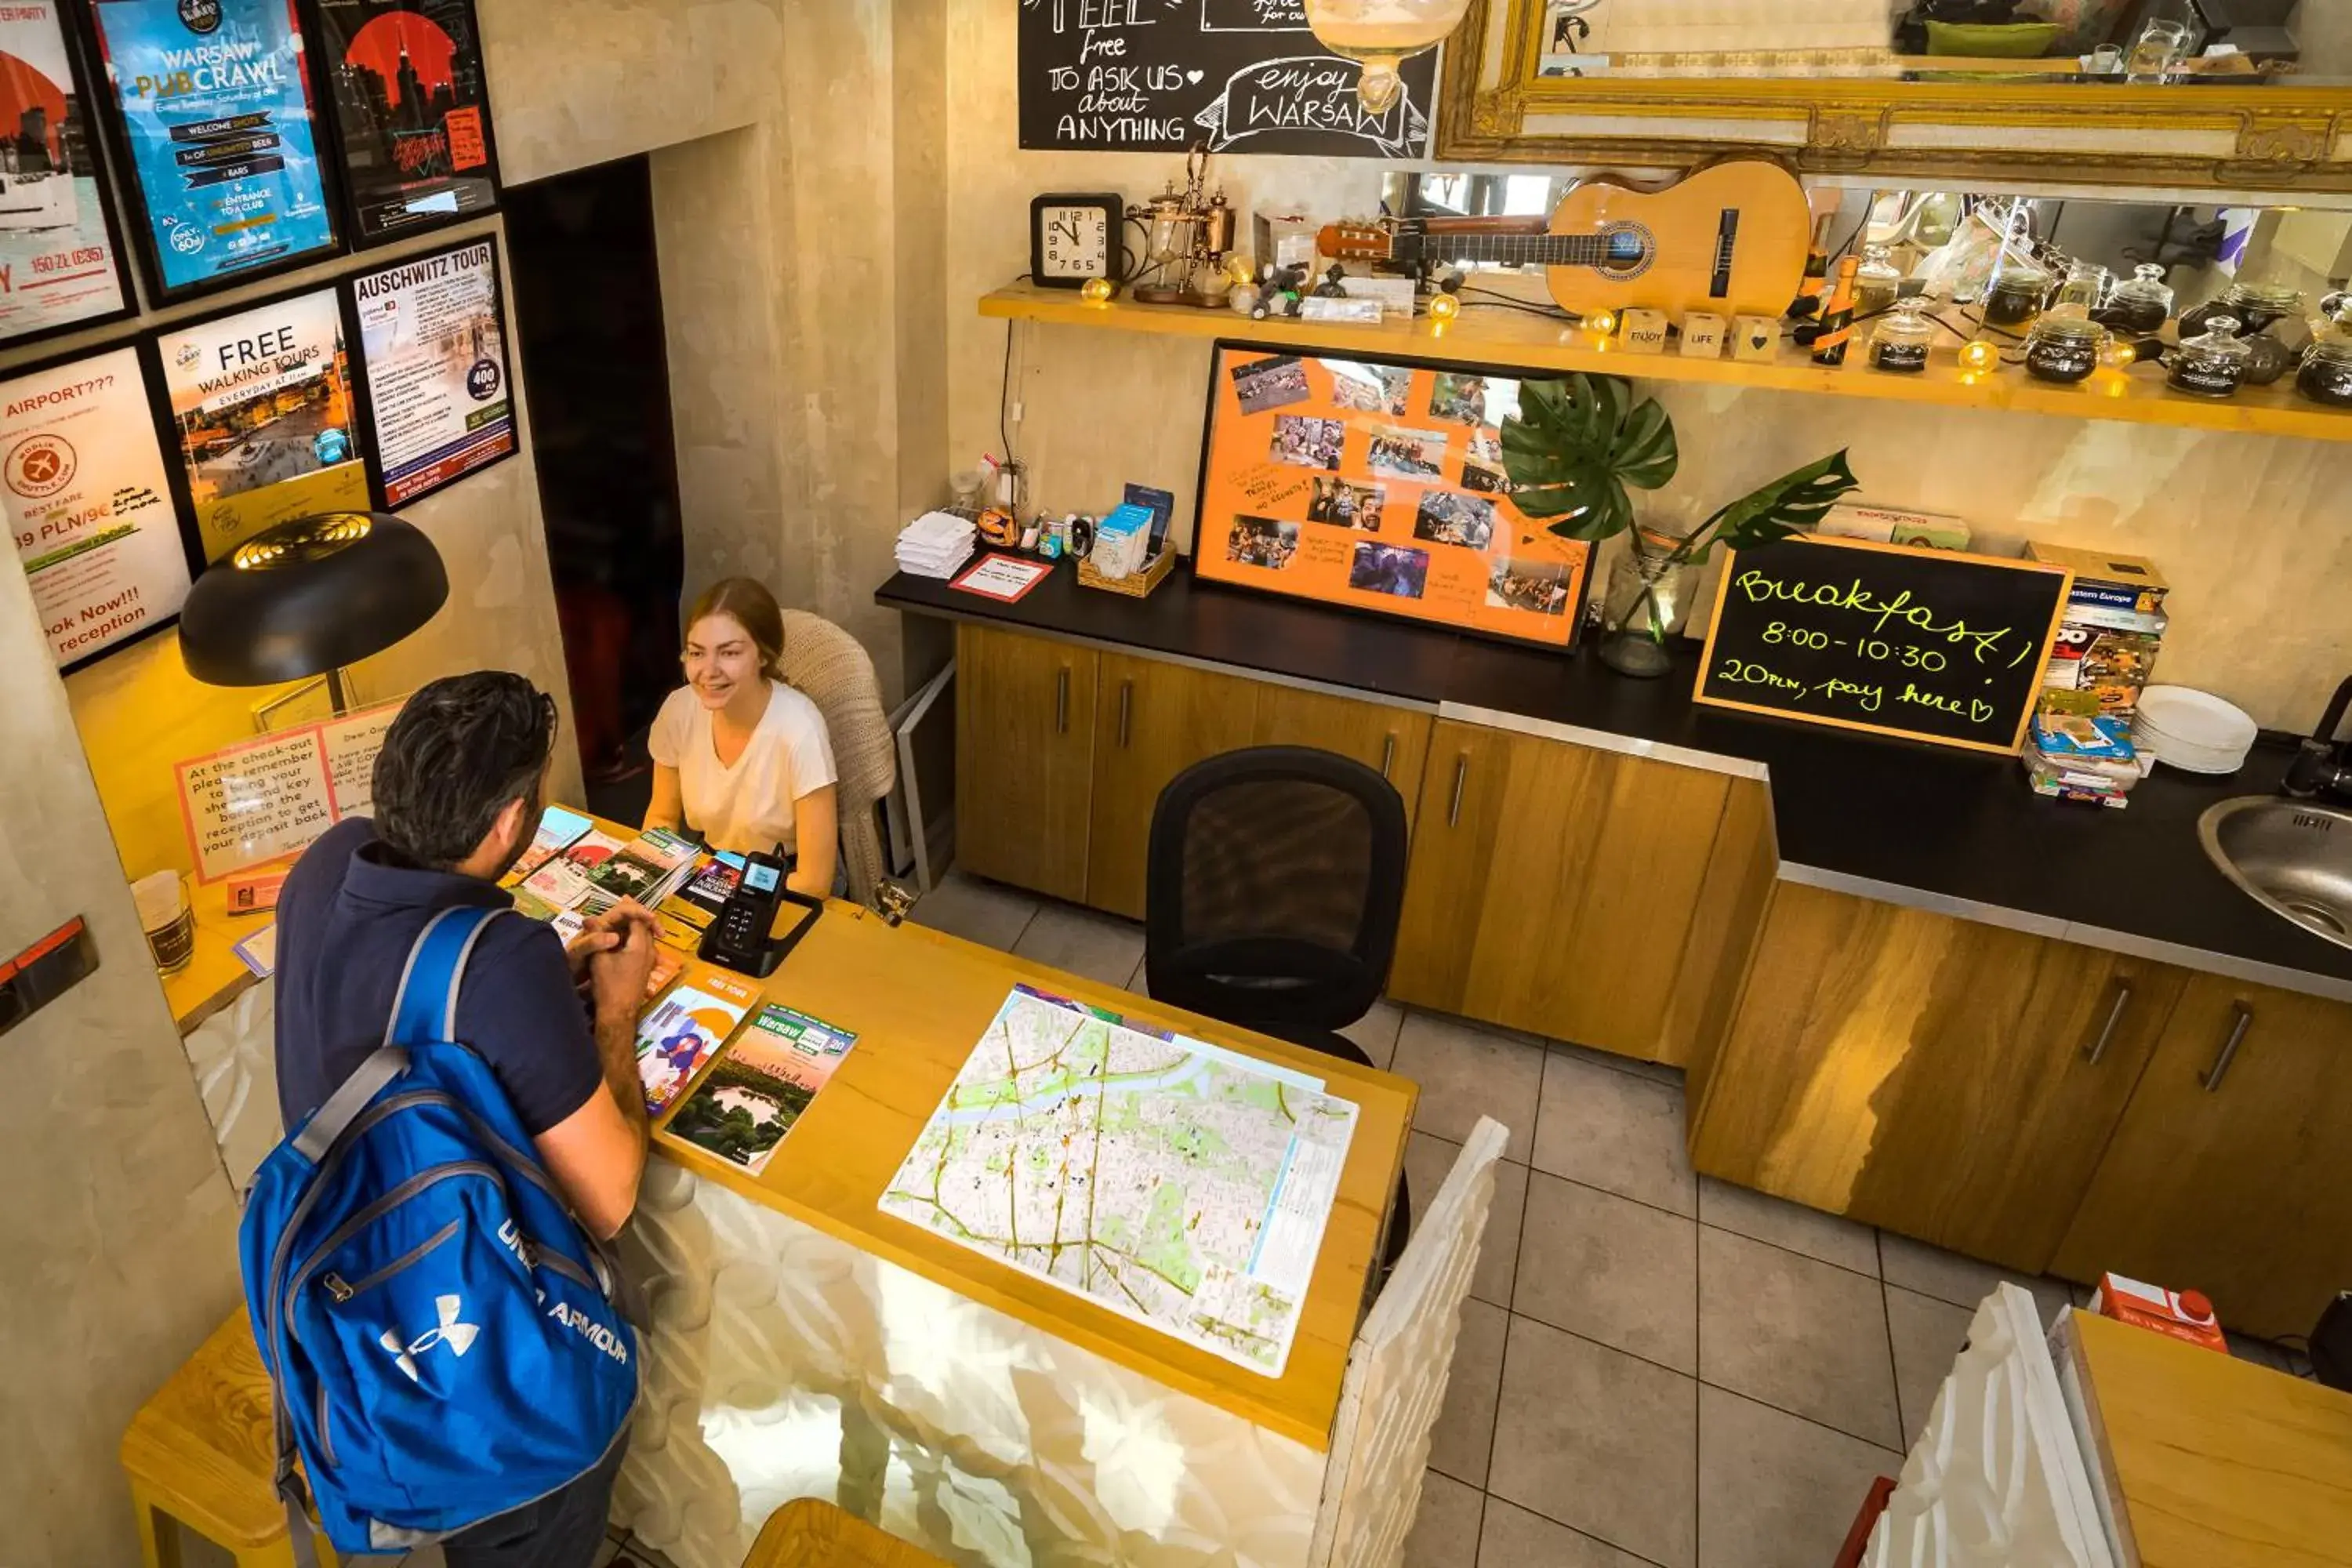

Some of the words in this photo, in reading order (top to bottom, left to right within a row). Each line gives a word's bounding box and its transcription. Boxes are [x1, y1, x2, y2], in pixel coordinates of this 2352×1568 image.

[161, 42, 254, 70] WARSAW
[1079, 28, 1127, 65] free
[136, 71, 193, 99] PUB
[193, 54, 287, 91] CRAWL
[1047, 65, 1080, 92] TO
[1087, 64, 1142, 92] ASK
[1146, 63, 1185, 92] US
[1254, 61, 1359, 101] enjoy
[1077, 90, 1150, 114] about
[188, 121, 233, 135] WELCOME
[1056, 115, 1185, 142] ANYTHING
[1249, 96, 1389, 136] WARSAW
[1070, 211, 1082, 221] 12
[1048, 236, 1058, 245] 9
[31, 256, 55, 274] 150
[1048, 250, 1058, 260] 8
[1059, 260, 1067, 269] 7
[1073, 260, 1081, 270] 6
[1086, 260, 1094, 270] 5
[358, 256, 449, 302] AUSCHWITZ
[451, 245, 490, 273] TOUR
[218, 325, 296, 372] FREE
[1629, 330, 1664, 343] ENJOY
[1690, 333, 1713, 345] LIFE
[198, 361, 271, 395] WALKING
[274, 344, 321, 374] TOURS
[473, 368, 495, 385] 400
[6, 376, 114, 418] AIRPORT???
[219, 381, 273, 406] EVERYDAY
[24, 502, 53, 519] BEST
[80, 586, 140, 623] Now!!!
[2069, 590, 2098, 600] astern
[2099, 591, 2132, 603] Europe
[58, 606, 147, 653] reception
[1761, 621, 1829, 651] 8:00
[1857, 637, 1947, 672] 10:30
[1813, 677, 1885, 713] pay
[1895, 683, 1966, 713] here
[191, 768, 206, 780] At
[212, 760, 235, 774] the
[241, 738, 313, 765] check-out
[243, 751, 314, 778] remember
[209, 789, 224, 800] to
[270, 767, 303, 782] your
[286, 776, 312, 789] key
[280, 792, 303, 804] the
[202, 837, 235, 856] your
[239, 821, 290, 842] deposit
[294, 808, 328, 826] back
[205, 814, 273, 840] reception
[278, 808, 292, 818] to
[298, 799, 321, 815] get
[757, 1014, 802, 1038] Warsaw
[547, 1301, 628, 1367] ARMOUR
